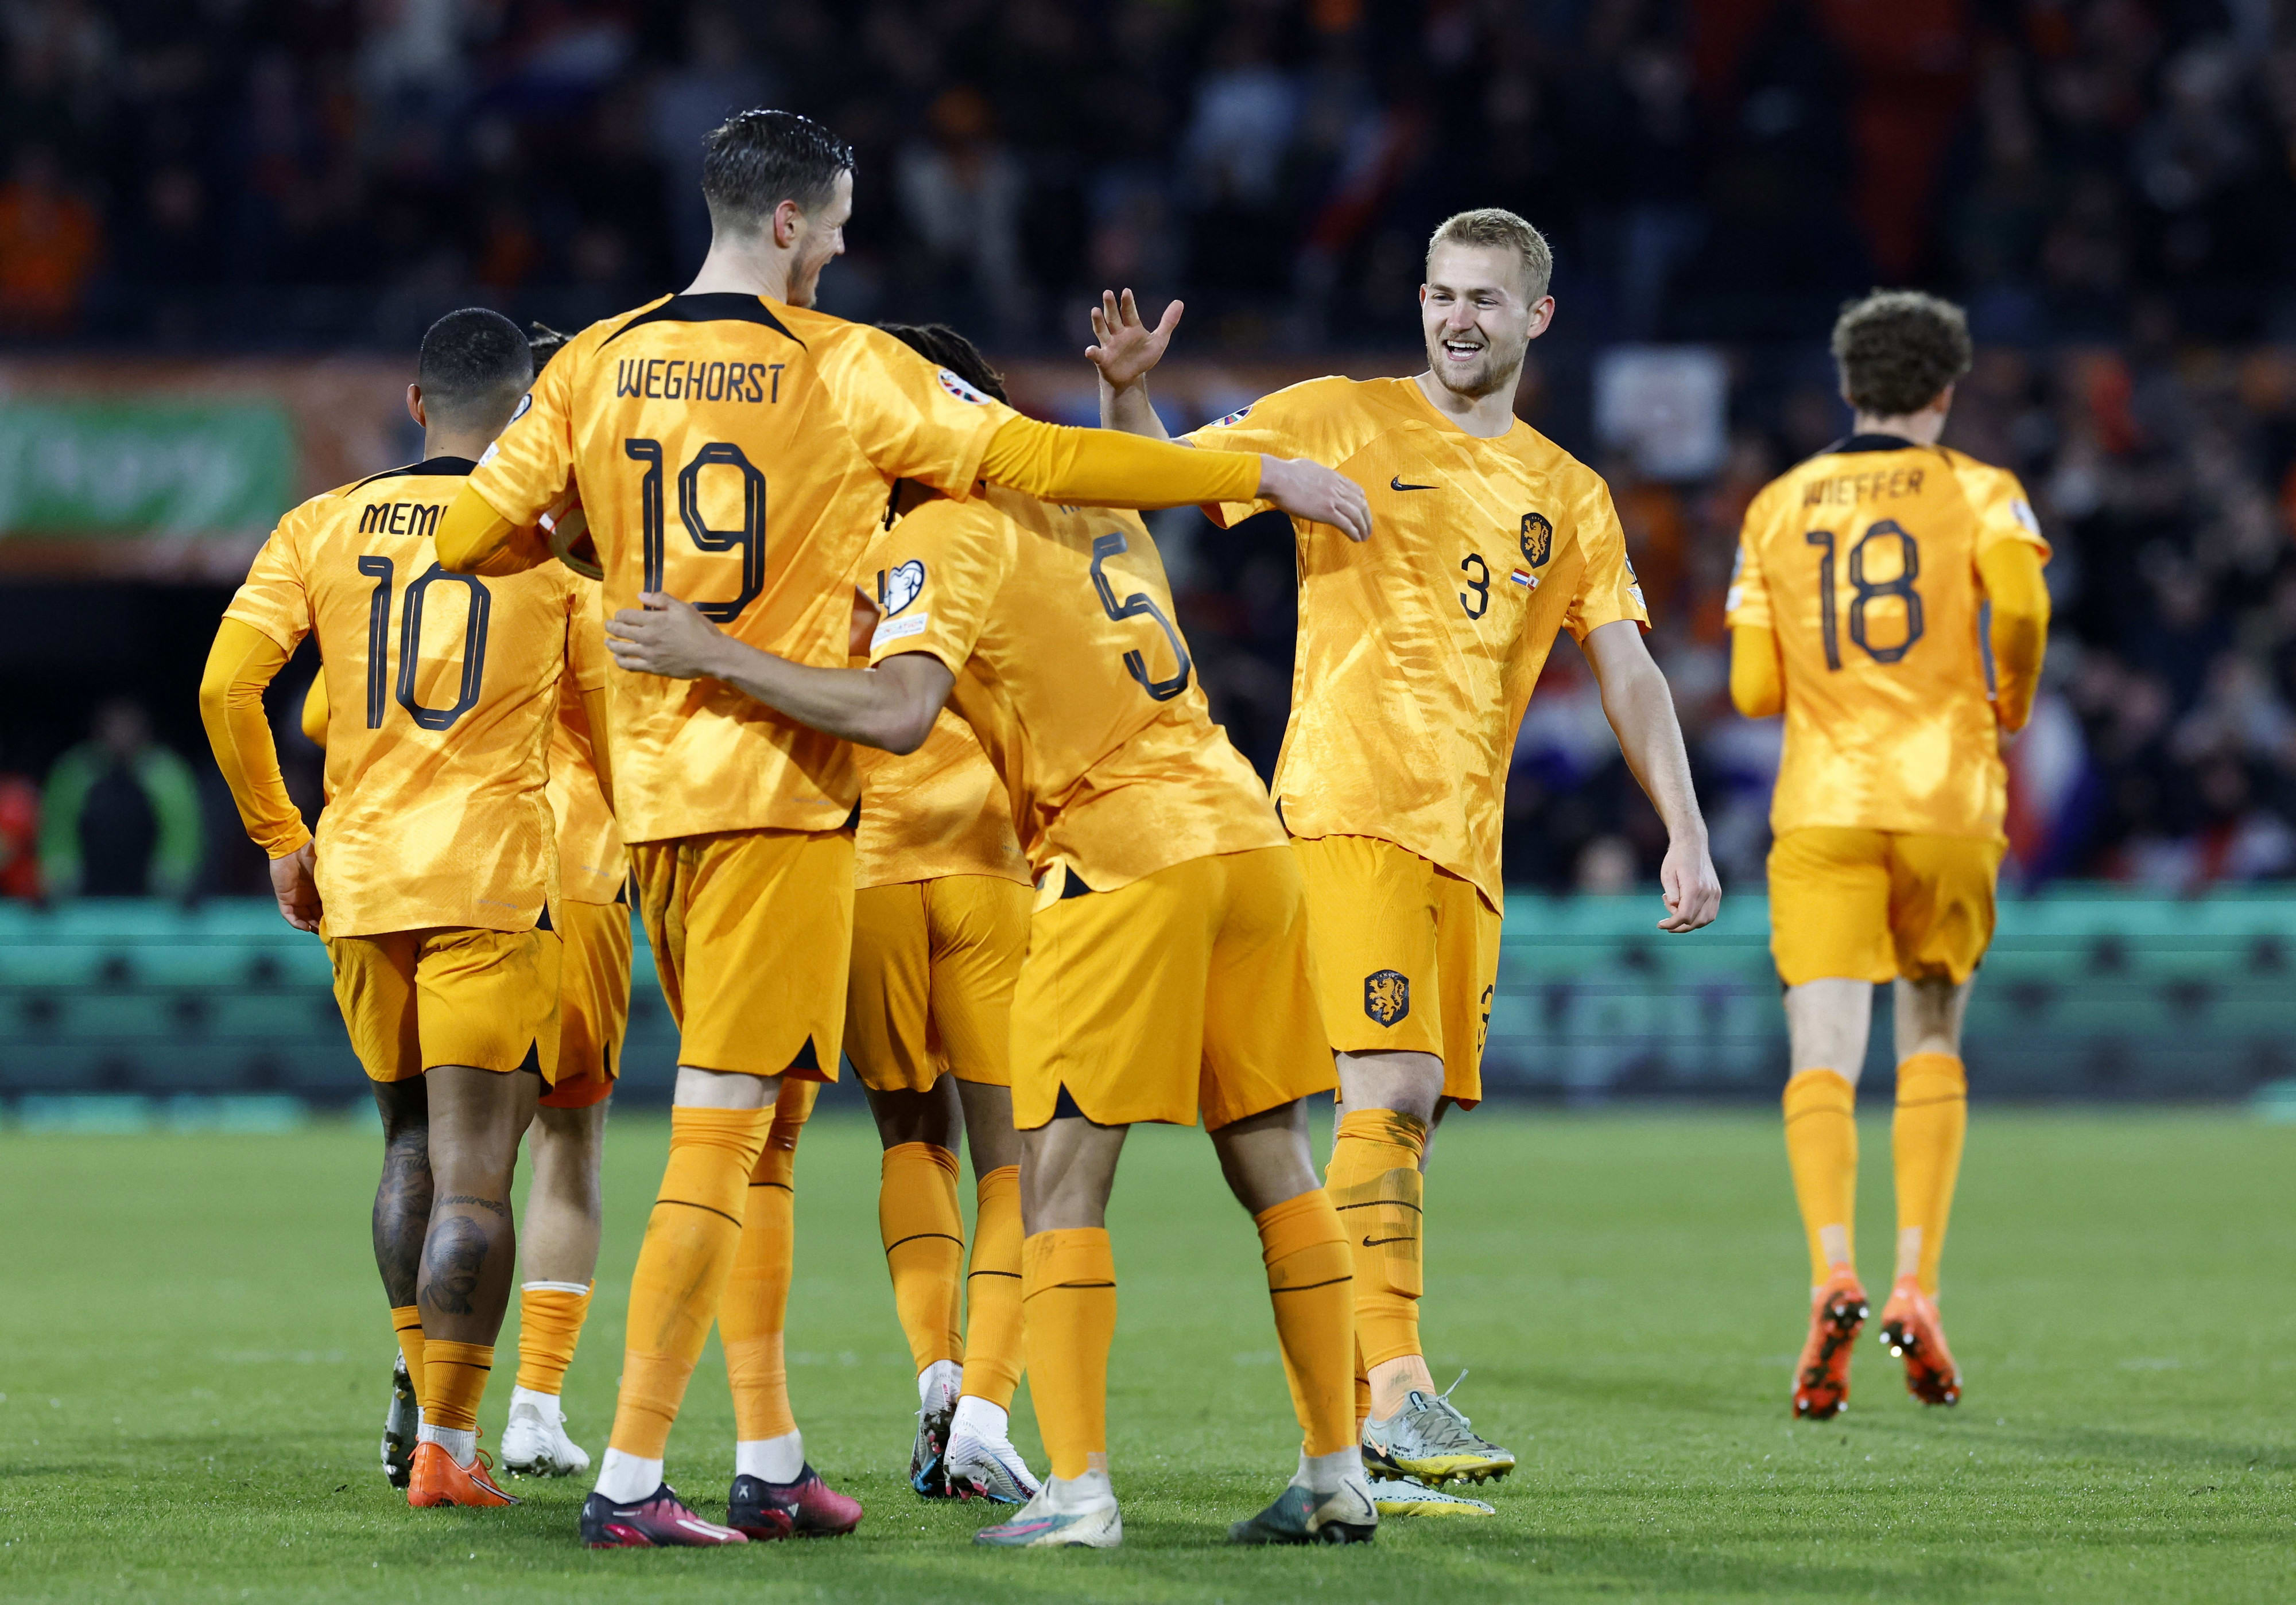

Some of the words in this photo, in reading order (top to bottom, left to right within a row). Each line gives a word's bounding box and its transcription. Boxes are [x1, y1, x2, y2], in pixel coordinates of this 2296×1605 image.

[617, 359, 785, 403] WEGHORST
[359, 503, 448, 537] MEM
[625, 438, 766, 623] 19
[1803, 467, 1924, 508] WIEFFER
[1090, 531, 1191, 701] 5
[1460, 553, 1490, 620] 3
[1805, 519, 1925, 672] 18
[358, 555, 491, 731] 10
